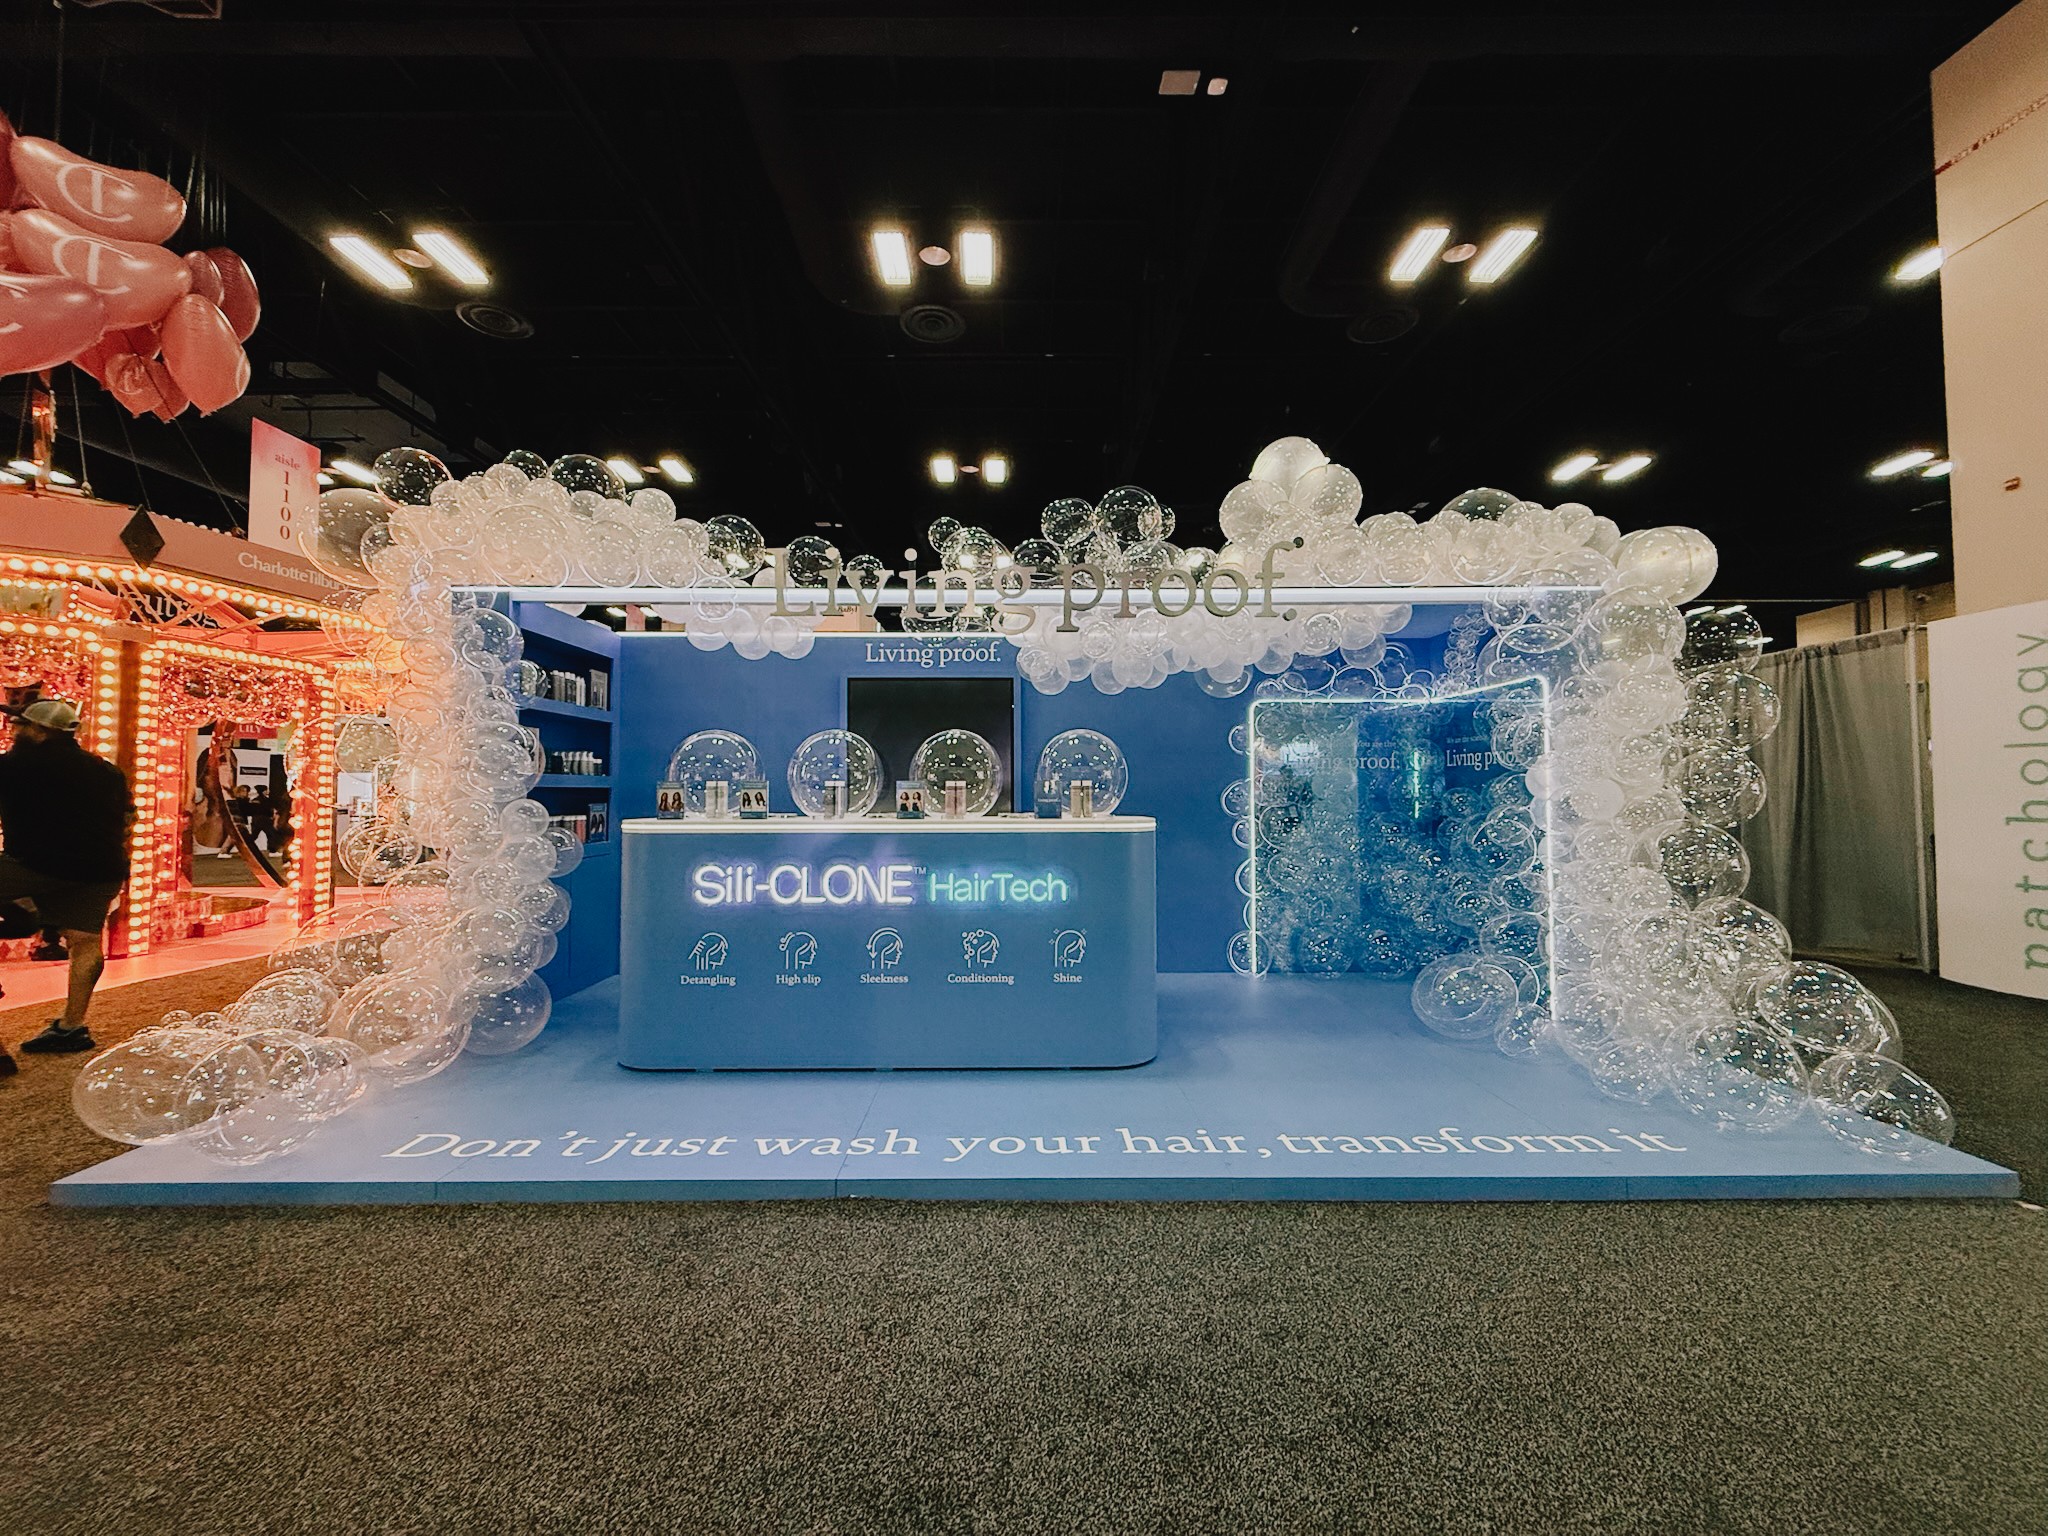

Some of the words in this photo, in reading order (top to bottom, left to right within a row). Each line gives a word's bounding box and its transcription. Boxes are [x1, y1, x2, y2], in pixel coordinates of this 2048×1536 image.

[274, 454, 301, 470] aisle
[770, 547, 1036, 635] Living
[865, 642, 934, 669] Living
[938, 640, 1001, 668] proof.
[1446, 748, 1482, 771] Living
[929, 872, 1070, 902] HairTech
[680, 975, 737, 987] Detangling
[776, 974, 801, 986] High
[802, 975, 822, 986] slip
[859, 974, 909, 984] Sleekness
[947, 974, 1015, 985] Conditioning
[1053, 973, 1082, 983] Shine
[584, 1131, 738, 1165] just
[753, 1129, 921, 1156] wash
[943, 1136, 1101, 1162] your
[1276, 1127, 1622, 1154] transform
[1607, 1128, 1688, 1152] it
